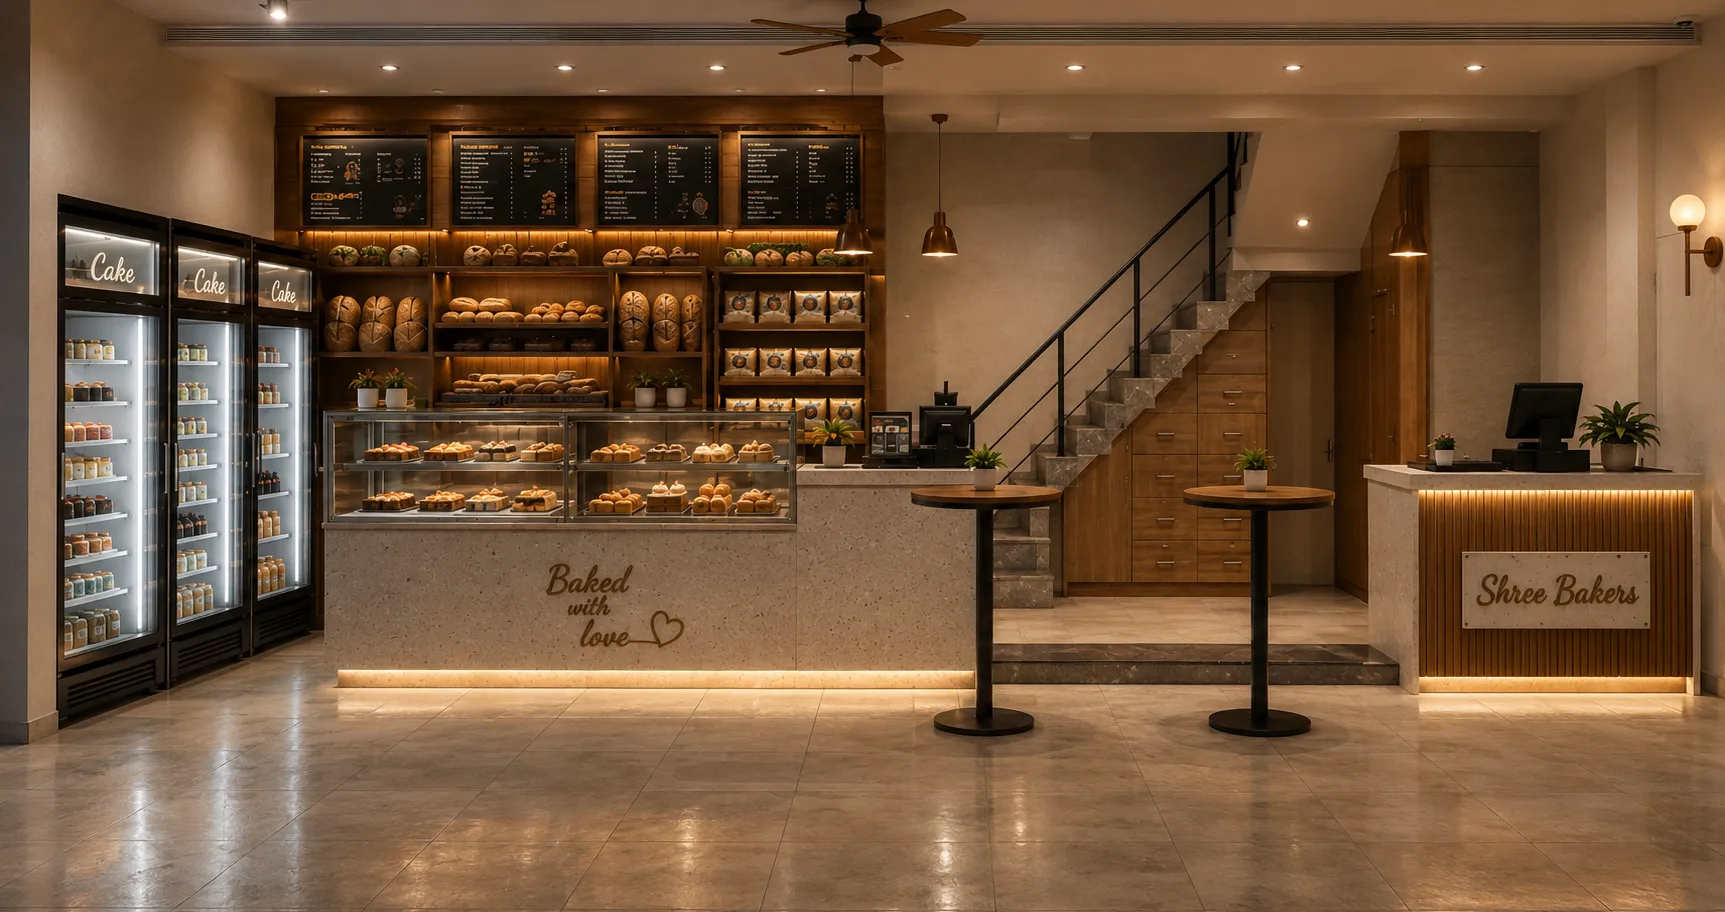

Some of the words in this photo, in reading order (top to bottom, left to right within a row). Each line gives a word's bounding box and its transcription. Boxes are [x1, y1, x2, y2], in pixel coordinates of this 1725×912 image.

[90, 252, 136, 284] Cake
[194, 268, 226, 295] Cake
[271, 280, 297, 304] Cake
[546, 563, 633, 596] Baked
[1476, 573, 1547, 606] Shree
[1553, 573, 1640, 607] Bakers
[567, 595, 611, 616] with
[580, 618, 630, 647] love
